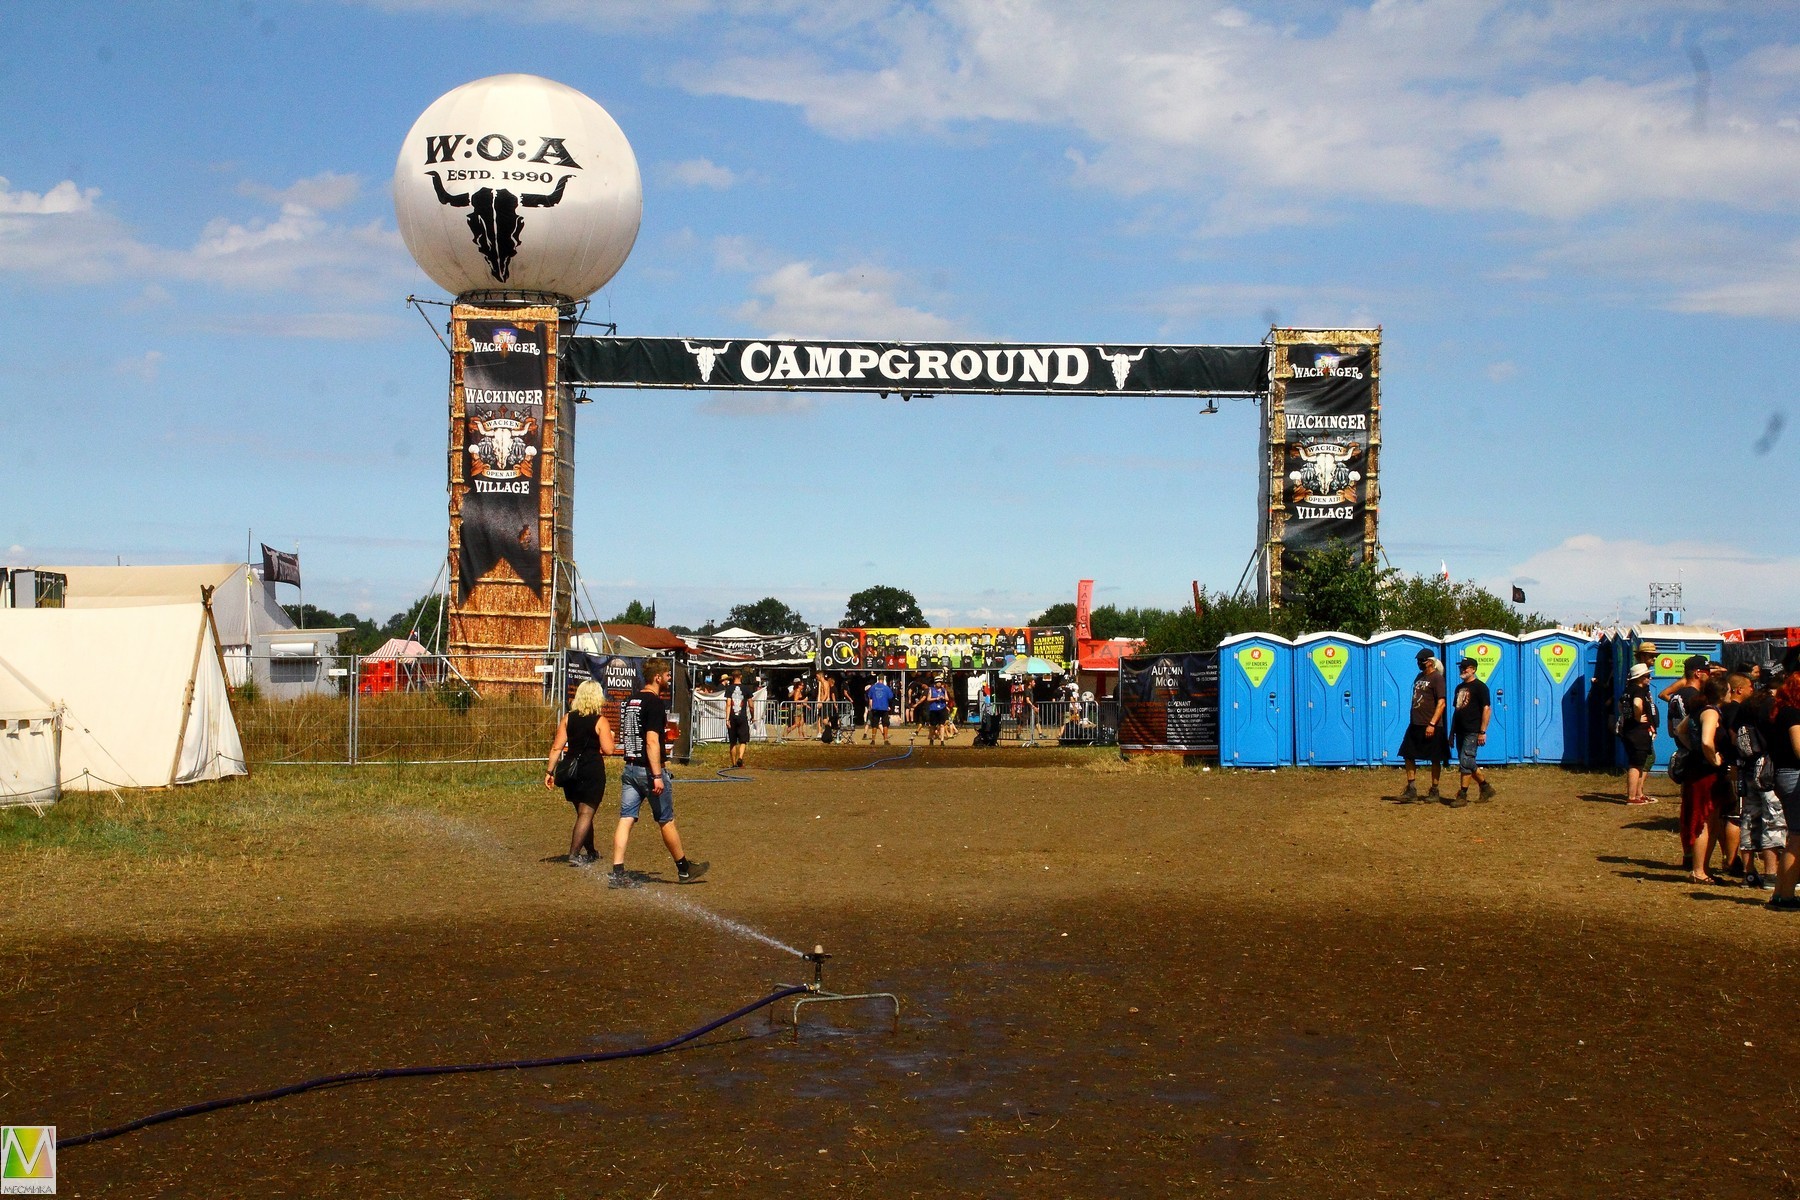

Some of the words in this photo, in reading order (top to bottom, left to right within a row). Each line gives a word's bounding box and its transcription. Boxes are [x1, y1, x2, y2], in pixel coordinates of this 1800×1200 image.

[424, 134, 583, 169] W:O:A
[446, 169, 495, 181] ESTD.
[502, 171, 554, 183] 1990
[740, 342, 1089, 384] CAMPGROUND
[465, 388, 543, 405] WACKINGER
[486, 419, 520, 429] WACKEN
[1286, 414, 1366, 430] WACKINGER
[1308, 444, 1343, 453] WACKEN
[474, 480, 530, 494] VILLAGE
[1296, 506, 1353, 519] VILLAGE
[605, 665, 636, 677] AUTUMN
[1151, 665, 1183, 676] AUTUMN
[607, 677, 632, 687] MOON
[1155, 677, 1179, 687] MOON
